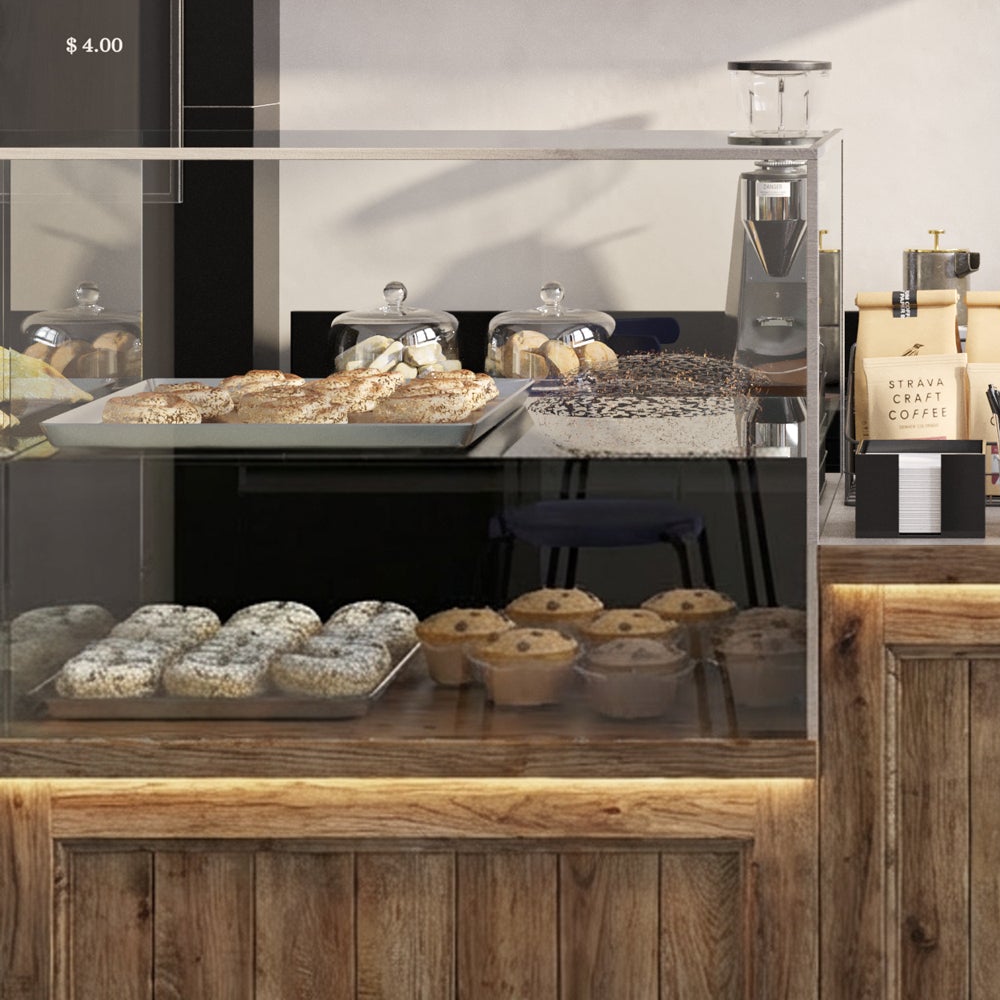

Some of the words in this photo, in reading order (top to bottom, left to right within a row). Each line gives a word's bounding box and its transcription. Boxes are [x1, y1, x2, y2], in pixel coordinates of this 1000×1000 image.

[66, 37, 77, 55] $
[82, 38, 123, 52] 4.00
[888, 378, 944, 389] STRAVA
[892, 392, 941, 404] CRAFT
[888, 408, 947, 420] COFFEE
